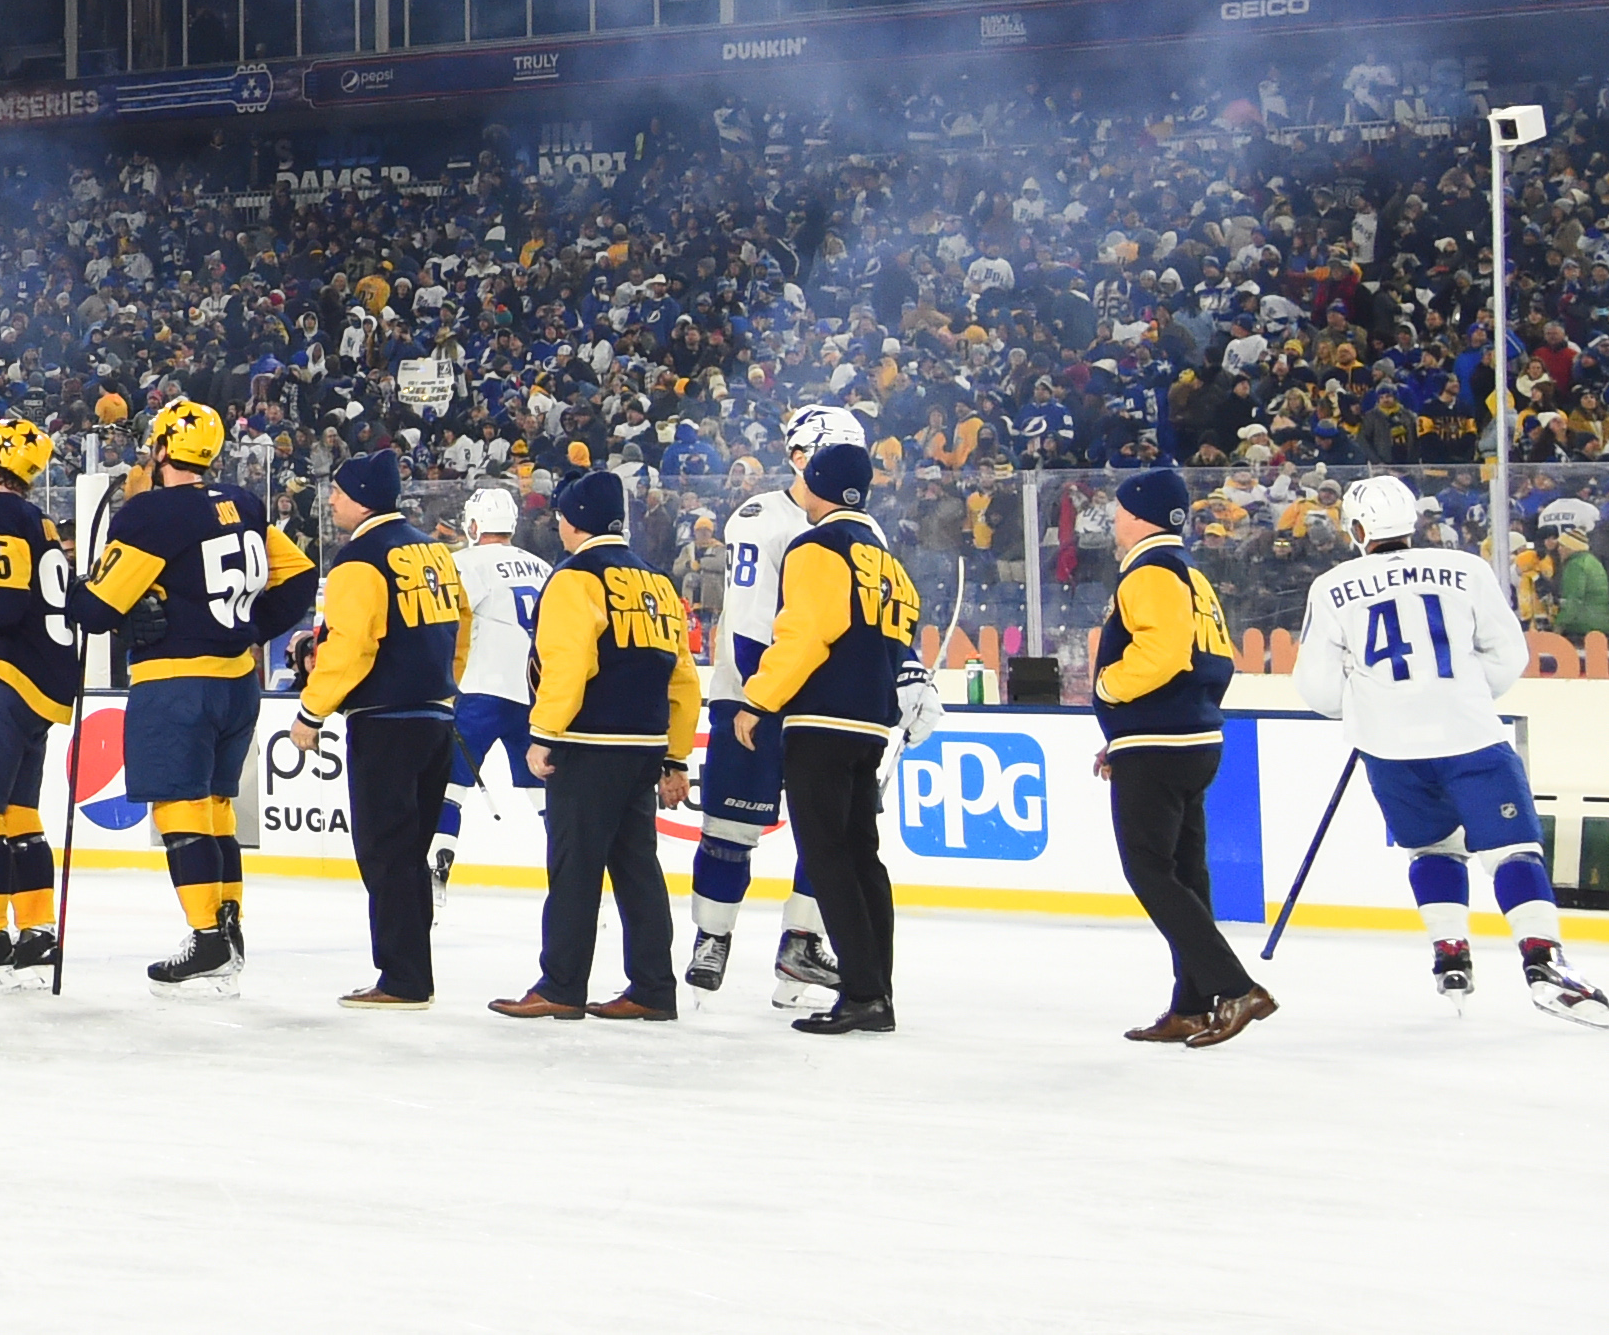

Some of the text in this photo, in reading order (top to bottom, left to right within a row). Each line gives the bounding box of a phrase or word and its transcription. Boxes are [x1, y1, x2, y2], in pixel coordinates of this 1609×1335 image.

[512, 53, 559, 70] TRULY
[722, 37, 808, 60] DUNKIN'
[360, 68, 394, 88] pepsi
[214, 500, 242, 526] JOSI
[200, 529, 269, 630] 59
[387, 541, 457, 592] SMASH
[1329, 565, 1469, 609] BELLEMARE
[396, 583, 461, 628] VILLE
[604, 566, 682, 621] SMASH
[610, 609, 681, 655] VILLE
[1364, 592, 1455, 682] 41
[723, 796, 774, 813] BAUER
[903, 741, 1043, 850] PPG
[264, 806, 352, 832] SUGA
